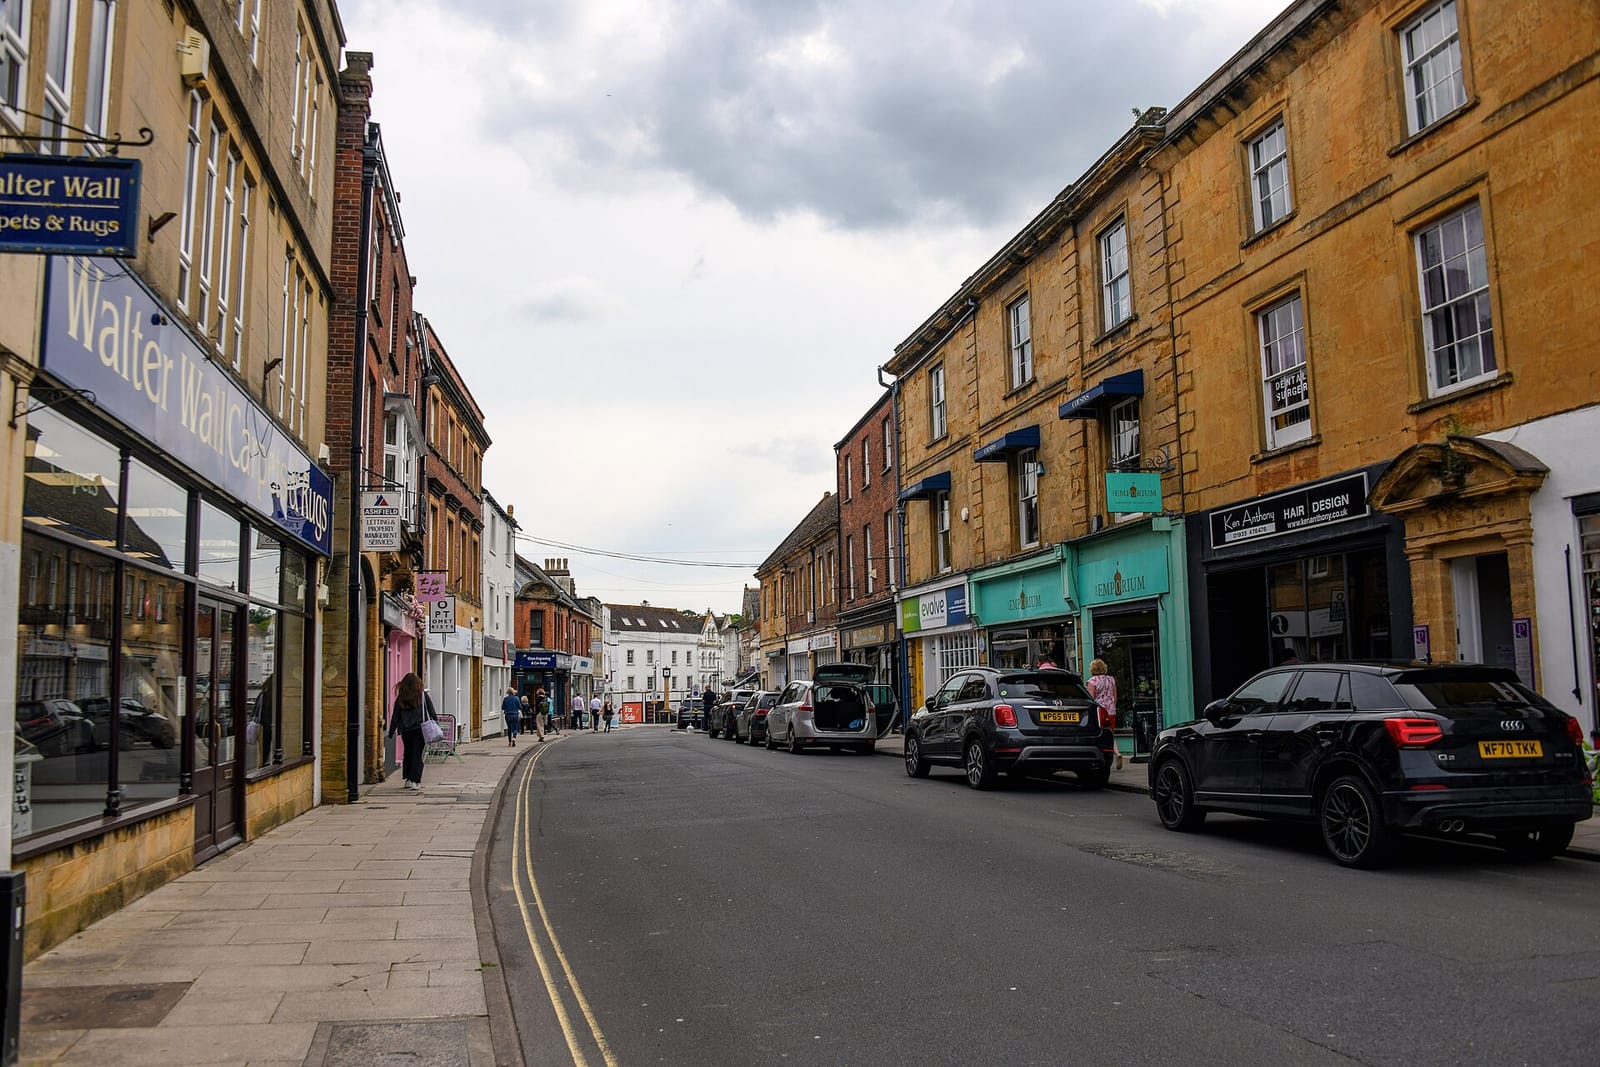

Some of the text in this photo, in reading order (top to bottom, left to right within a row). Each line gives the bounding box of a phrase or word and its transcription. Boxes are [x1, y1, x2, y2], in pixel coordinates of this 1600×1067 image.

[0, 172, 120, 199] lter Wall
[0, 213, 120, 236] pets & Rugs
[67, 254, 173, 412] Walter
[180, 352, 226, 456] Wall
[1275, 371, 1307, 391] DENTAL
[1275, 383, 1308, 401] SURGER
[1115, 488, 1157, 498] EMPORIUM
[1223, 493, 1350, 531] Ken Anthony HAIR DESIGN
[1286, 507, 1349, 529] www.kenanthony.co.uk
[1097, 574, 1145, 597] EMPORIUM
[921, 595, 945, 617] evolve
[1482, 743, 1538, 756] WF70 TKK
